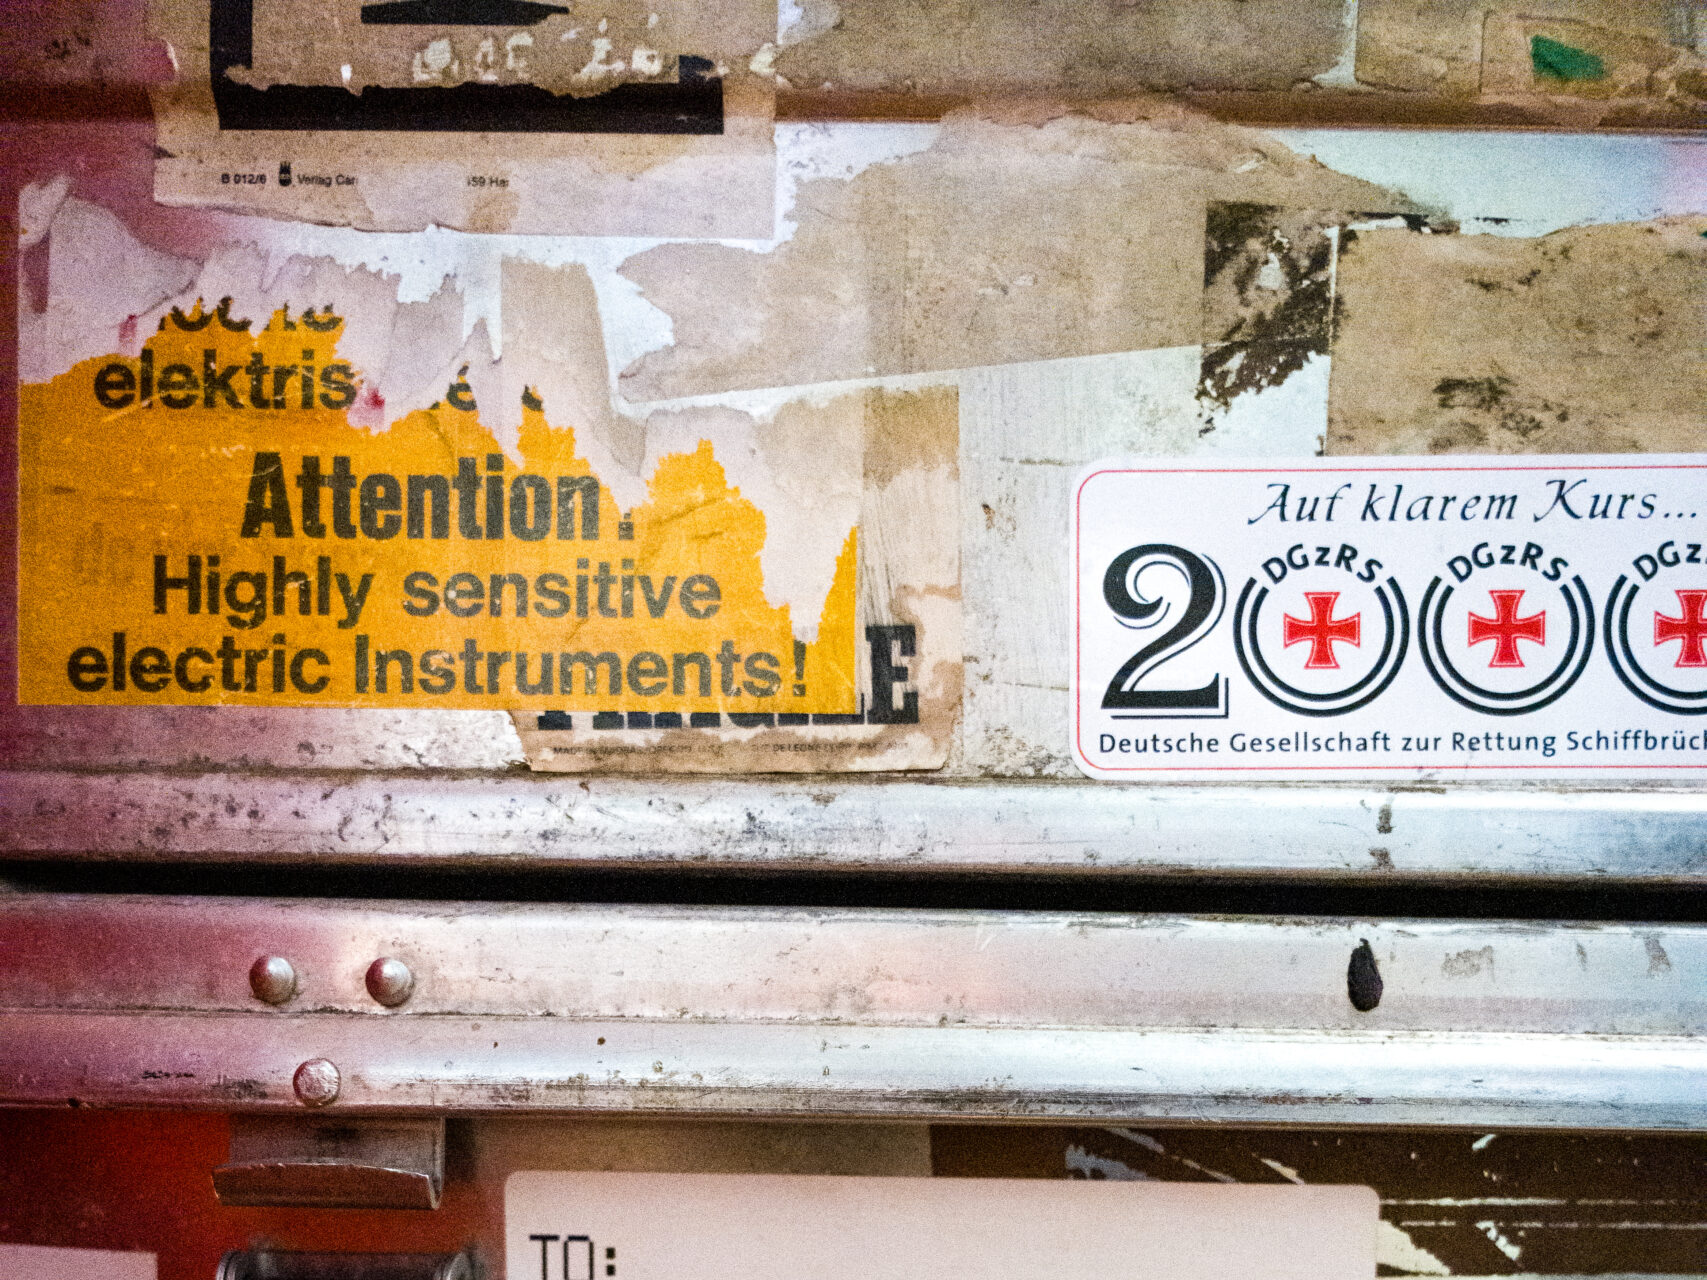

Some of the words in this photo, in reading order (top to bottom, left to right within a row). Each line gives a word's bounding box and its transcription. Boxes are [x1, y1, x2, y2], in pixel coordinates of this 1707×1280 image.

[1247, 482, 1352, 525] Auf
[1360, 483, 1518, 522] klarem
[1533, 477, 1698, 523] Kurs...
[1261, 543, 1383, 584] DGzRS
[1446, 541, 1569, 583] DGzRS
[1632, 540, 1707, 582] DGz
[152, 553, 374, 630] Highly
[402, 558, 722, 620] sensitive
[65, 630, 330, 694] electric
[354, 633, 807, 699] Instruments!
[1099, 732, 1220, 754] Deutsche
[1229, 730, 1391, 753] Gesellschaft
[1401, 736, 1442, 752] zur
[1451, 731, 1557, 758] Rettung
